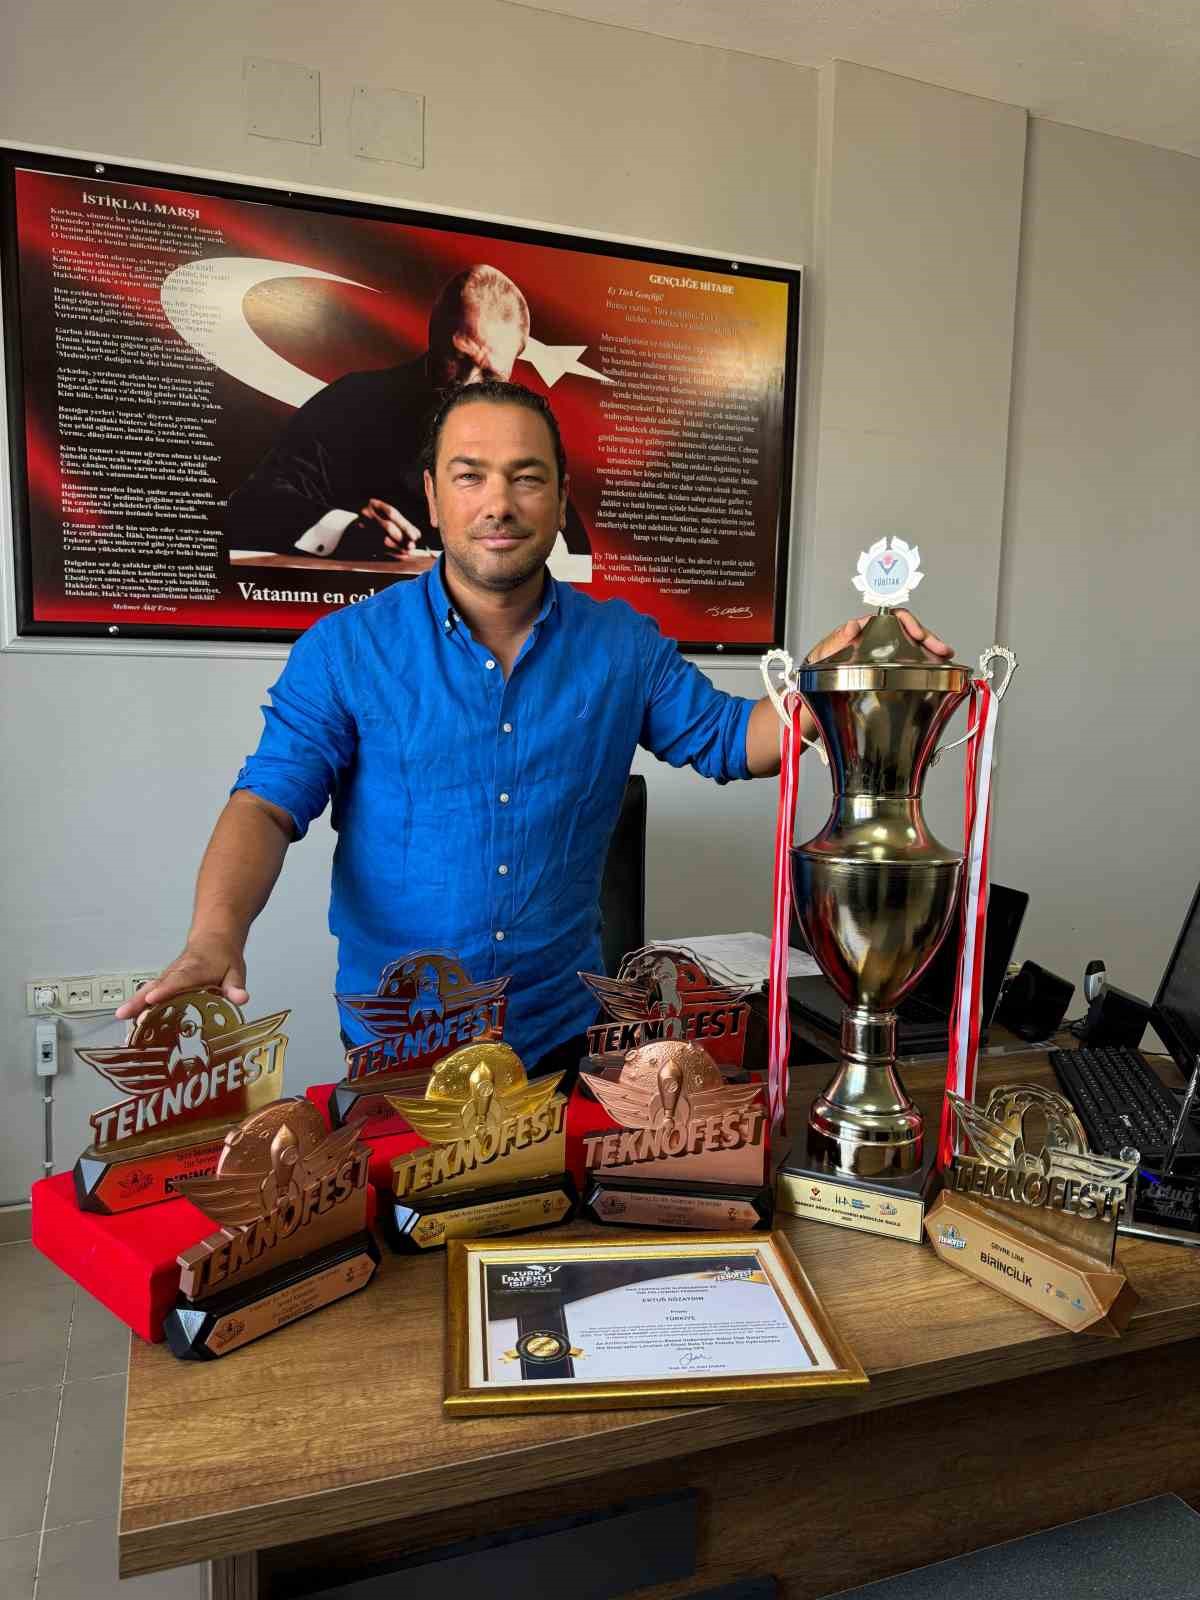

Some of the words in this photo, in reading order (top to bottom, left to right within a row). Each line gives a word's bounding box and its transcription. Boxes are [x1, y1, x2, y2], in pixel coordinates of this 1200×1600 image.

[154, 203, 200, 220] MARŞI
[649, 273, 699, 289] GENÇLİĞE
[700, 281, 735, 295] HİTABE
[238, 582, 318, 603] Vatanını
[323, 592, 345, 604] en
[348, 999, 506, 1082] TEKNOFEST
[94, 1036, 284, 1150] TEKNOFEST
[391, 1098, 567, 1198] TEKNOFEST
[584, 1108, 764, 1168] TEKNOFEST
[954, 1160, 1123, 1223] TEKNOFEST
[178, 1149, 373, 1301] TEKNOFEST
[979, 1251, 1033, 1288] BİRİNCİLİK
